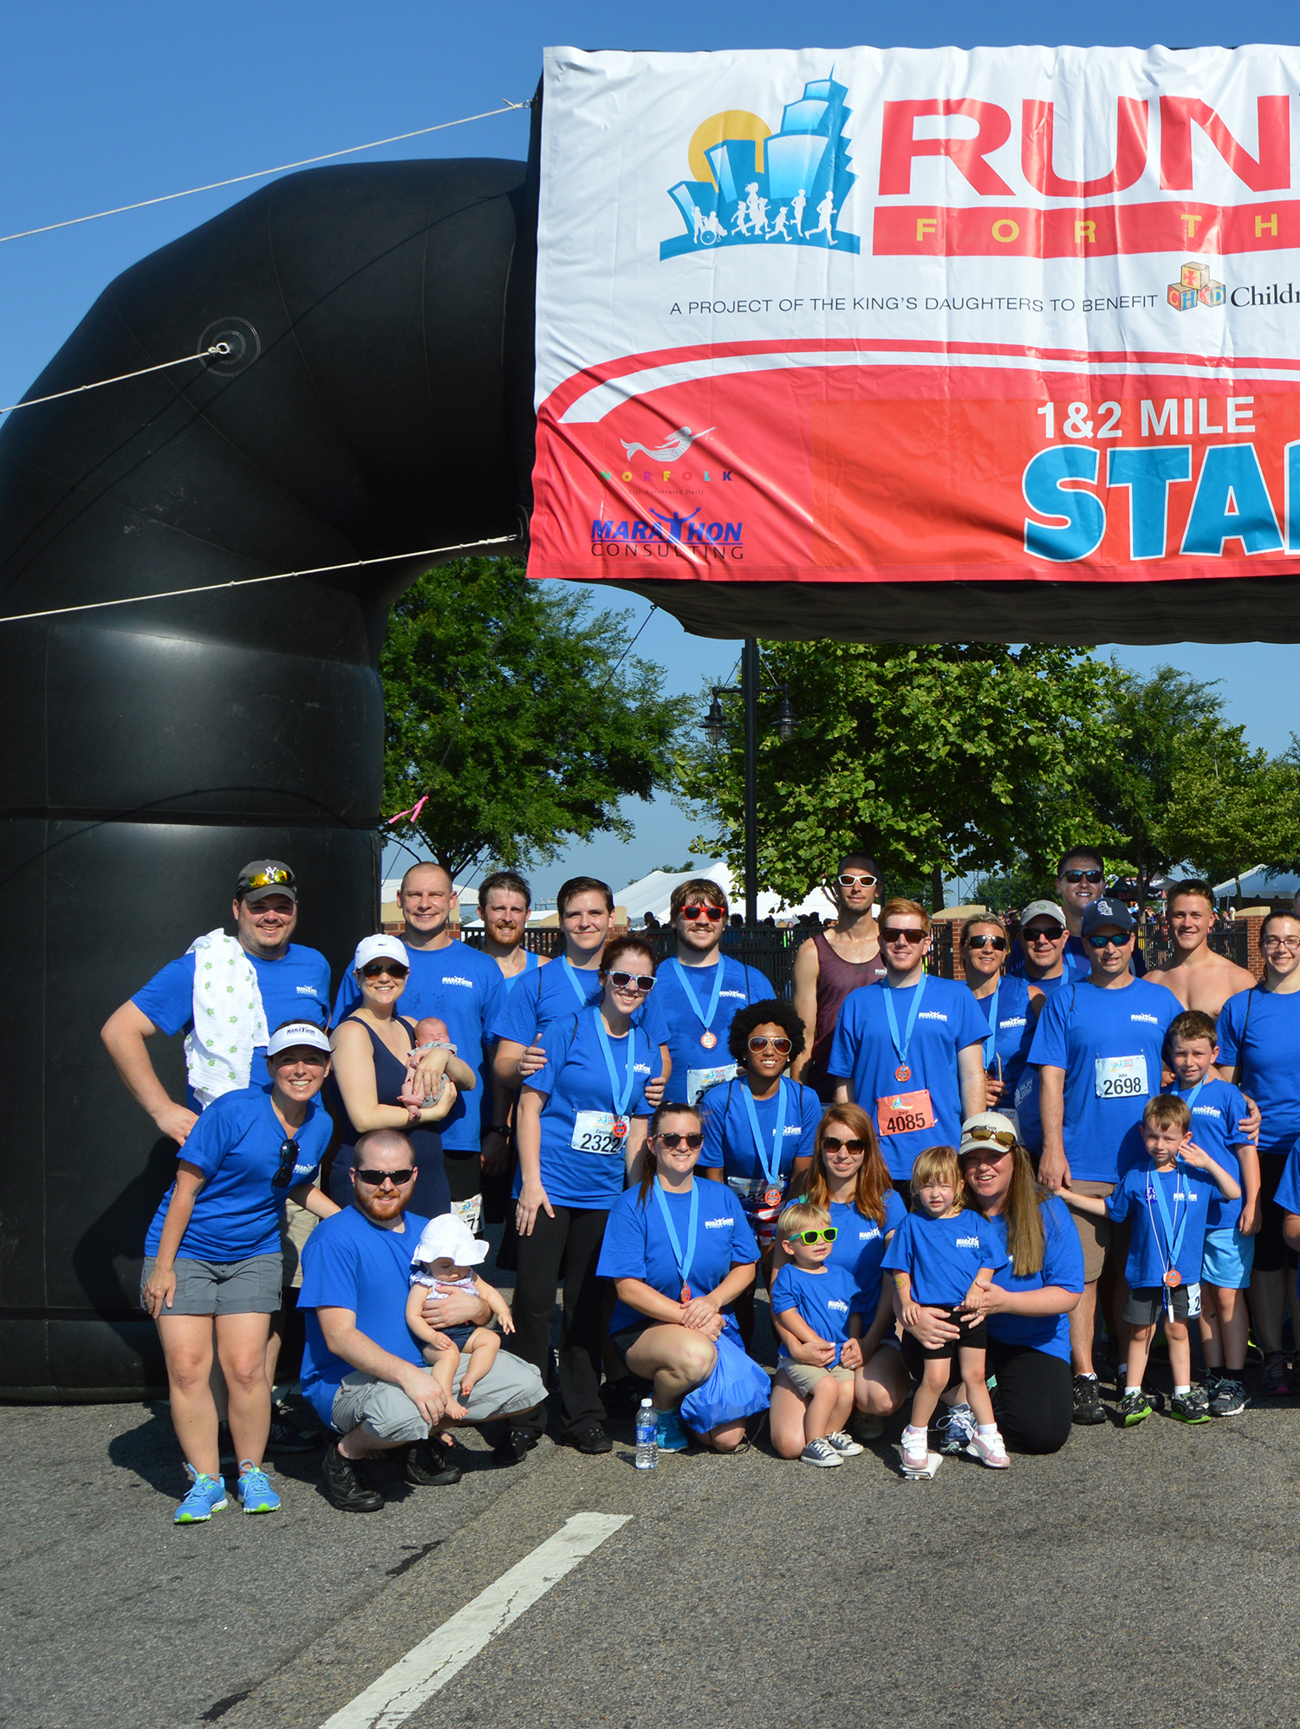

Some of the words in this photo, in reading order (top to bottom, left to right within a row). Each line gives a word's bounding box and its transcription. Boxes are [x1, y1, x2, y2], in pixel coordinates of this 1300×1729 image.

[916, 218, 1097, 244] FOR
[669, 302, 682, 315] A
[688, 299, 773, 314] PROJECT
[778, 298, 804, 312] OF
[810, 297, 846, 311] THE
[853, 297, 918, 310] KING'S
[925, 297, 1044, 312] DAUGHTERS
[1050, 298, 1075, 311] TO
[1082, 295, 1158, 312] BENEFIT
[1037, 400, 1123, 439] 1&2
[1140, 396, 1256, 437] MILE
[590, 543, 744, 560] CONSULTING
[1103, 1076, 1142, 1096] 2698
[887, 1113, 926, 1136] 4085
[580, 1132, 621, 1154] 2322
